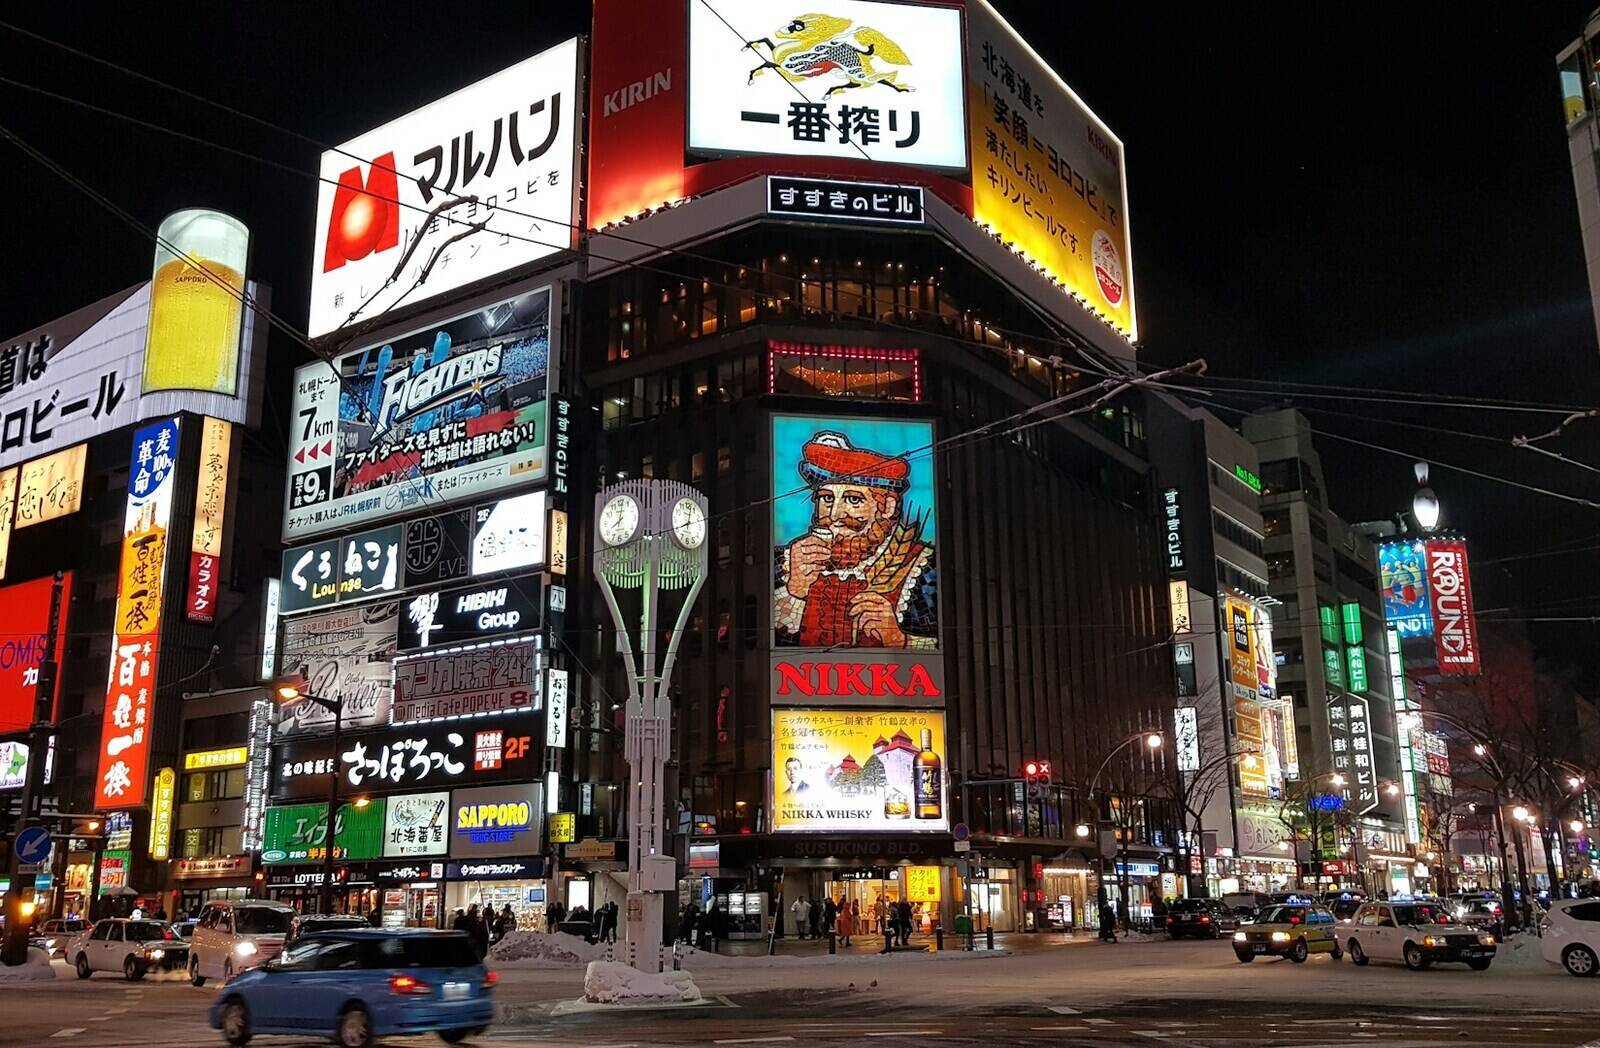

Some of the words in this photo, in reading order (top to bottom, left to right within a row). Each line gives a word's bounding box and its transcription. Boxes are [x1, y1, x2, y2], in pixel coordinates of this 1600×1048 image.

[603, 68, 672, 117] KIRIN
[982, 41, 1044, 119] 北海道を
[740, 102, 921, 148] 一番搾り
[414, 91, 561, 205] マルハン
[778, 186, 914, 214] すすきのビル
[174, 275, 208, 285] SAPPORO
[299, 371, 339, 395] 札幌ドーム
[310, 389, 325, 401] まで
[371, 344, 504, 444] FIGHTERS
[345, 425, 467, 470] ファイターズを見ずに
[554, 400, 571, 494] すすきのビル
[135, 441, 155, 494] 革命
[460, 468, 504, 486] ファイターズ
[437, 477, 457, 492] または
[477, 509, 490, 523] 2F
[1164, 489, 1184, 569] すすきのビル
[291, 540, 382, 592] くろねこ
[438, 560, 467, 578] EVE
[194, 555, 213, 611] カラオケ
[312, 577, 362, 601] Lounge
[457, 588, 508, 613] HIBIKI
[1431, 552, 1474, 664] ROUND1
[409, 592, 443, 647] 響
[479, 610, 520, 631] Group
[775, 662, 941, 698] NIKKA
[438, 699, 461, 716] Cafe
[463, 692, 505, 713] POPEYE
[342, 733, 465, 786] さっぽろっこ
[505, 736, 531, 759] 2F
[1350, 704, 1373, 801] 第23桂和ビル
[457, 802, 530, 829] SAPPORO
[782, 810, 824, 820] NIKKA
[826, 810, 873, 820] WHISKY
[390, 825, 443, 843] 北海番屋
[471, 832, 489, 843] DRUG
[490, 830, 513, 842] STORE
[794, 841, 881, 856] SUSUKINO
[888, 841, 924, 855] BLD.
